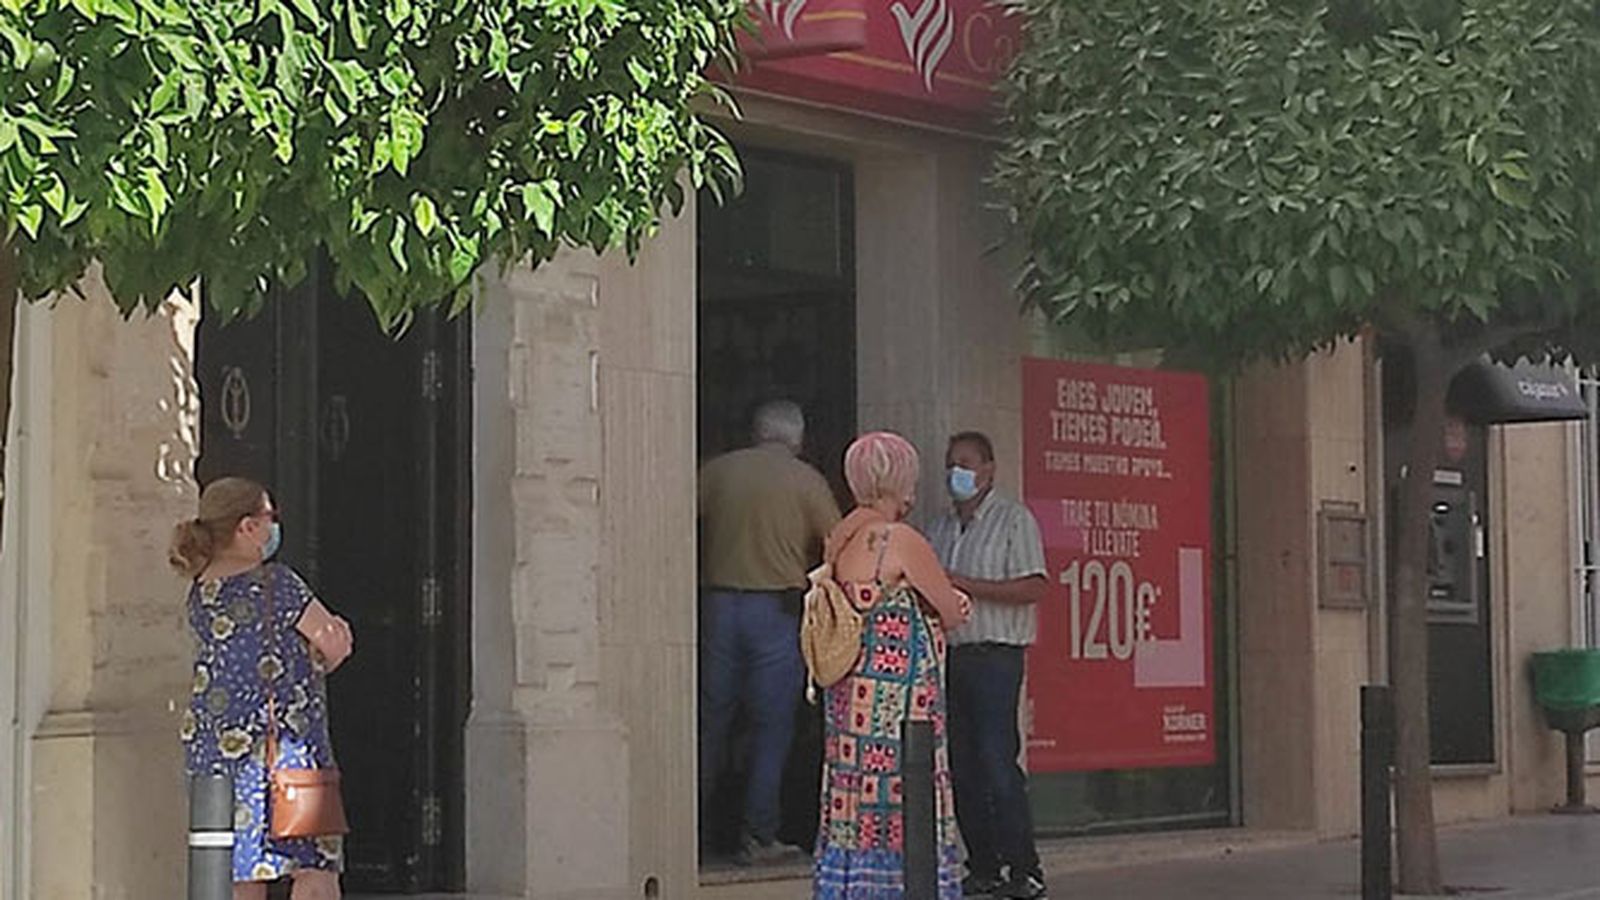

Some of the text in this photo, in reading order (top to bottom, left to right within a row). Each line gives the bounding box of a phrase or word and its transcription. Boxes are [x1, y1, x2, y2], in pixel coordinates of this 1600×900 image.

[1061, 499, 1091, 528] TRAE
[1094, 500, 1110, 528] TU
[1083, 529, 1090, 555] Y
